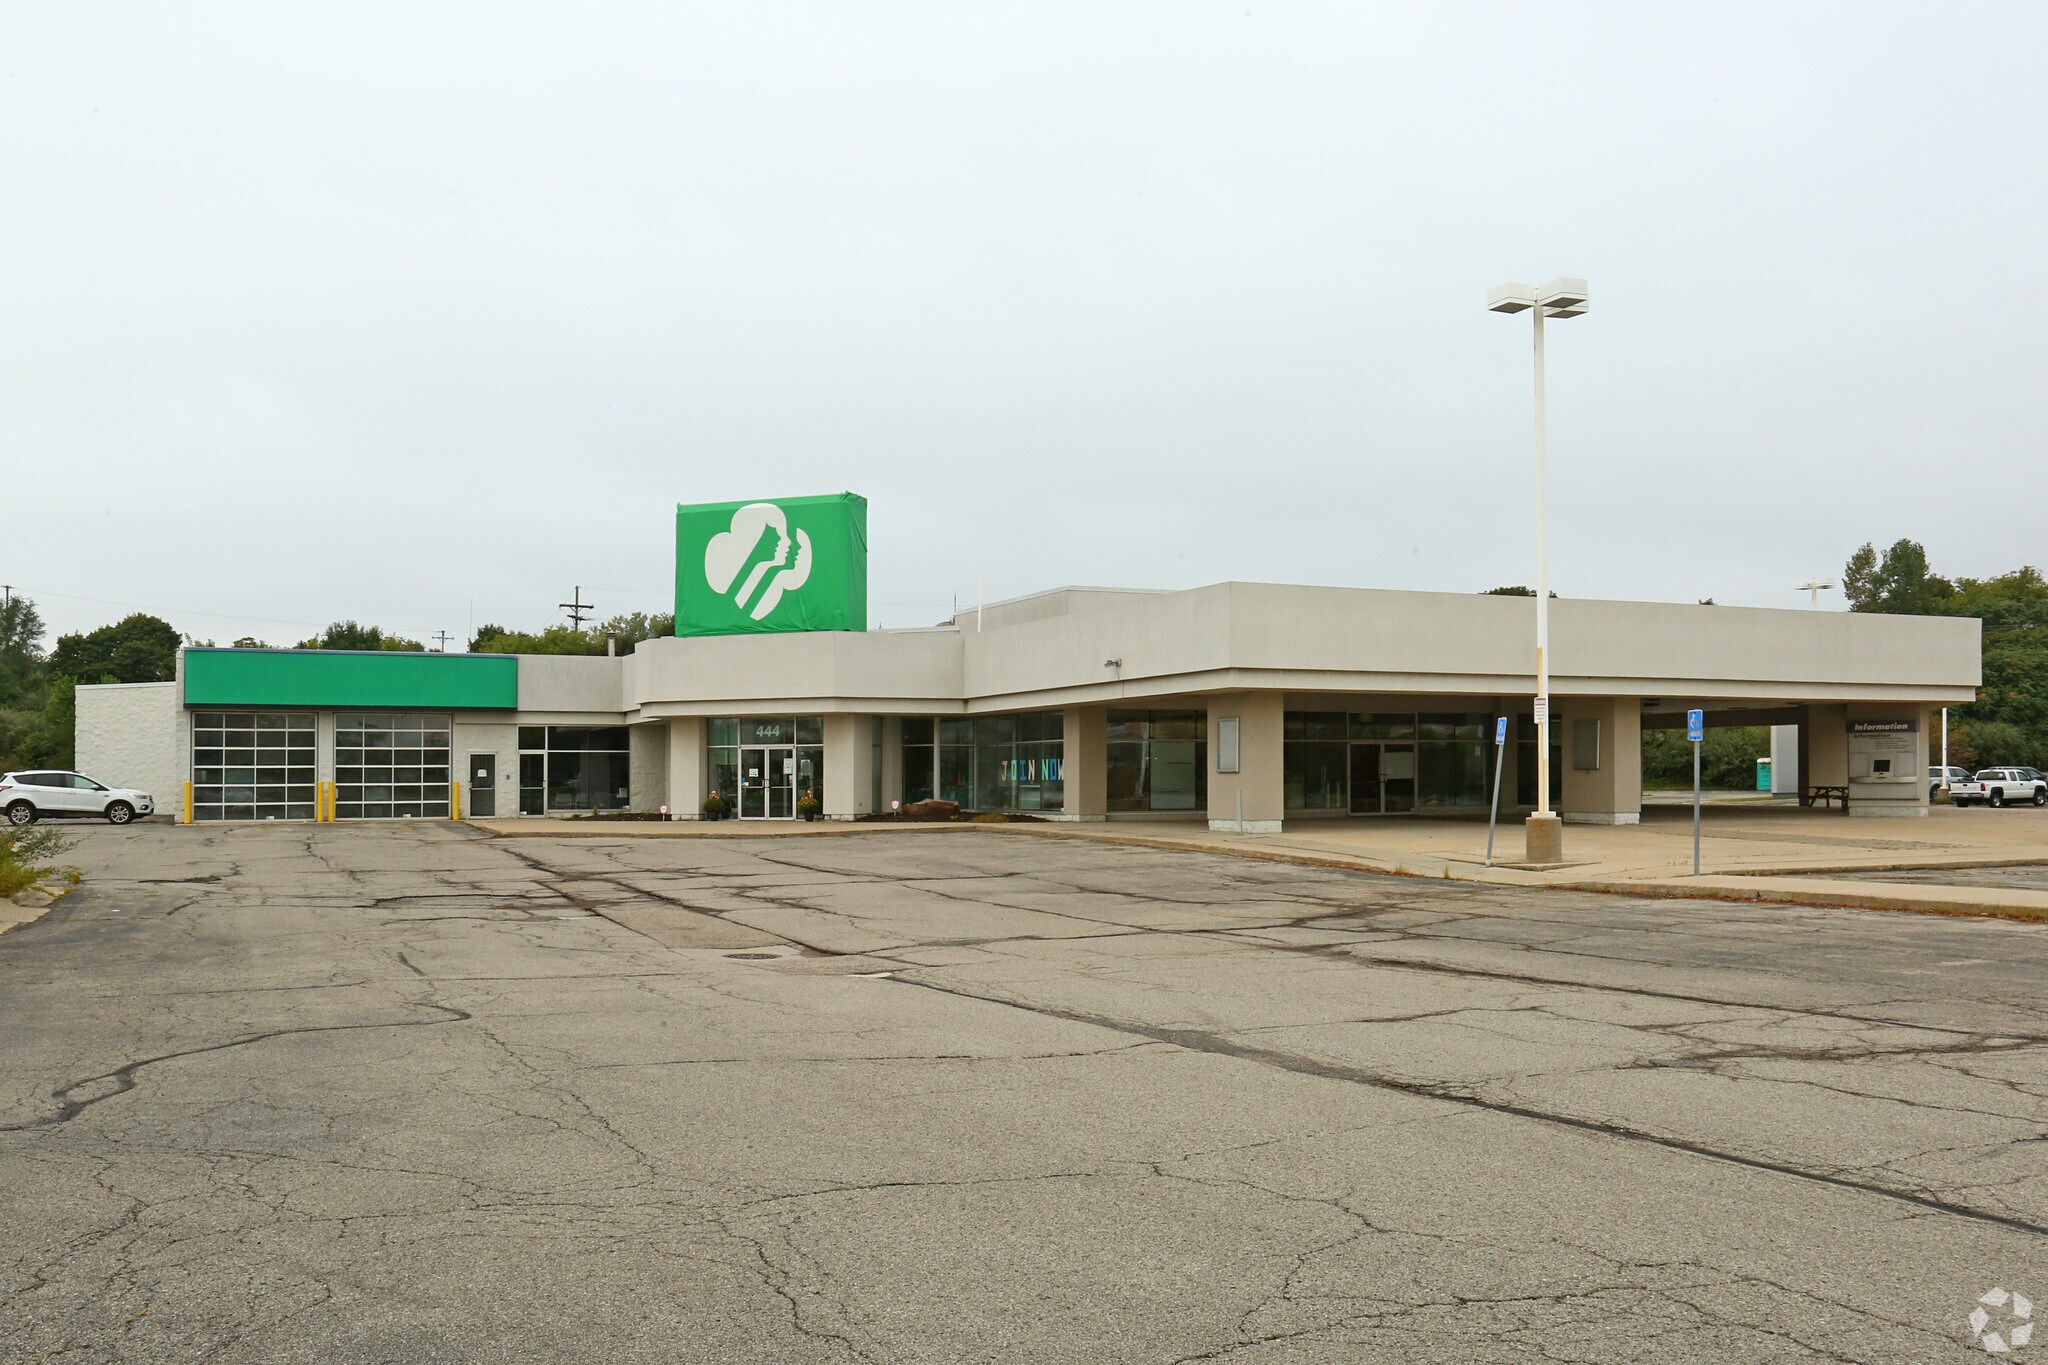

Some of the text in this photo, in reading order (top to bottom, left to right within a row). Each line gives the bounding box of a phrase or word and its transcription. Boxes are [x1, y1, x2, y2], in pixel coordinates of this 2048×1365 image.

[756, 725, 780, 737] 444
[1854, 722, 1908, 731] Information
[1001, 758, 1064, 781] JOIN NOW
